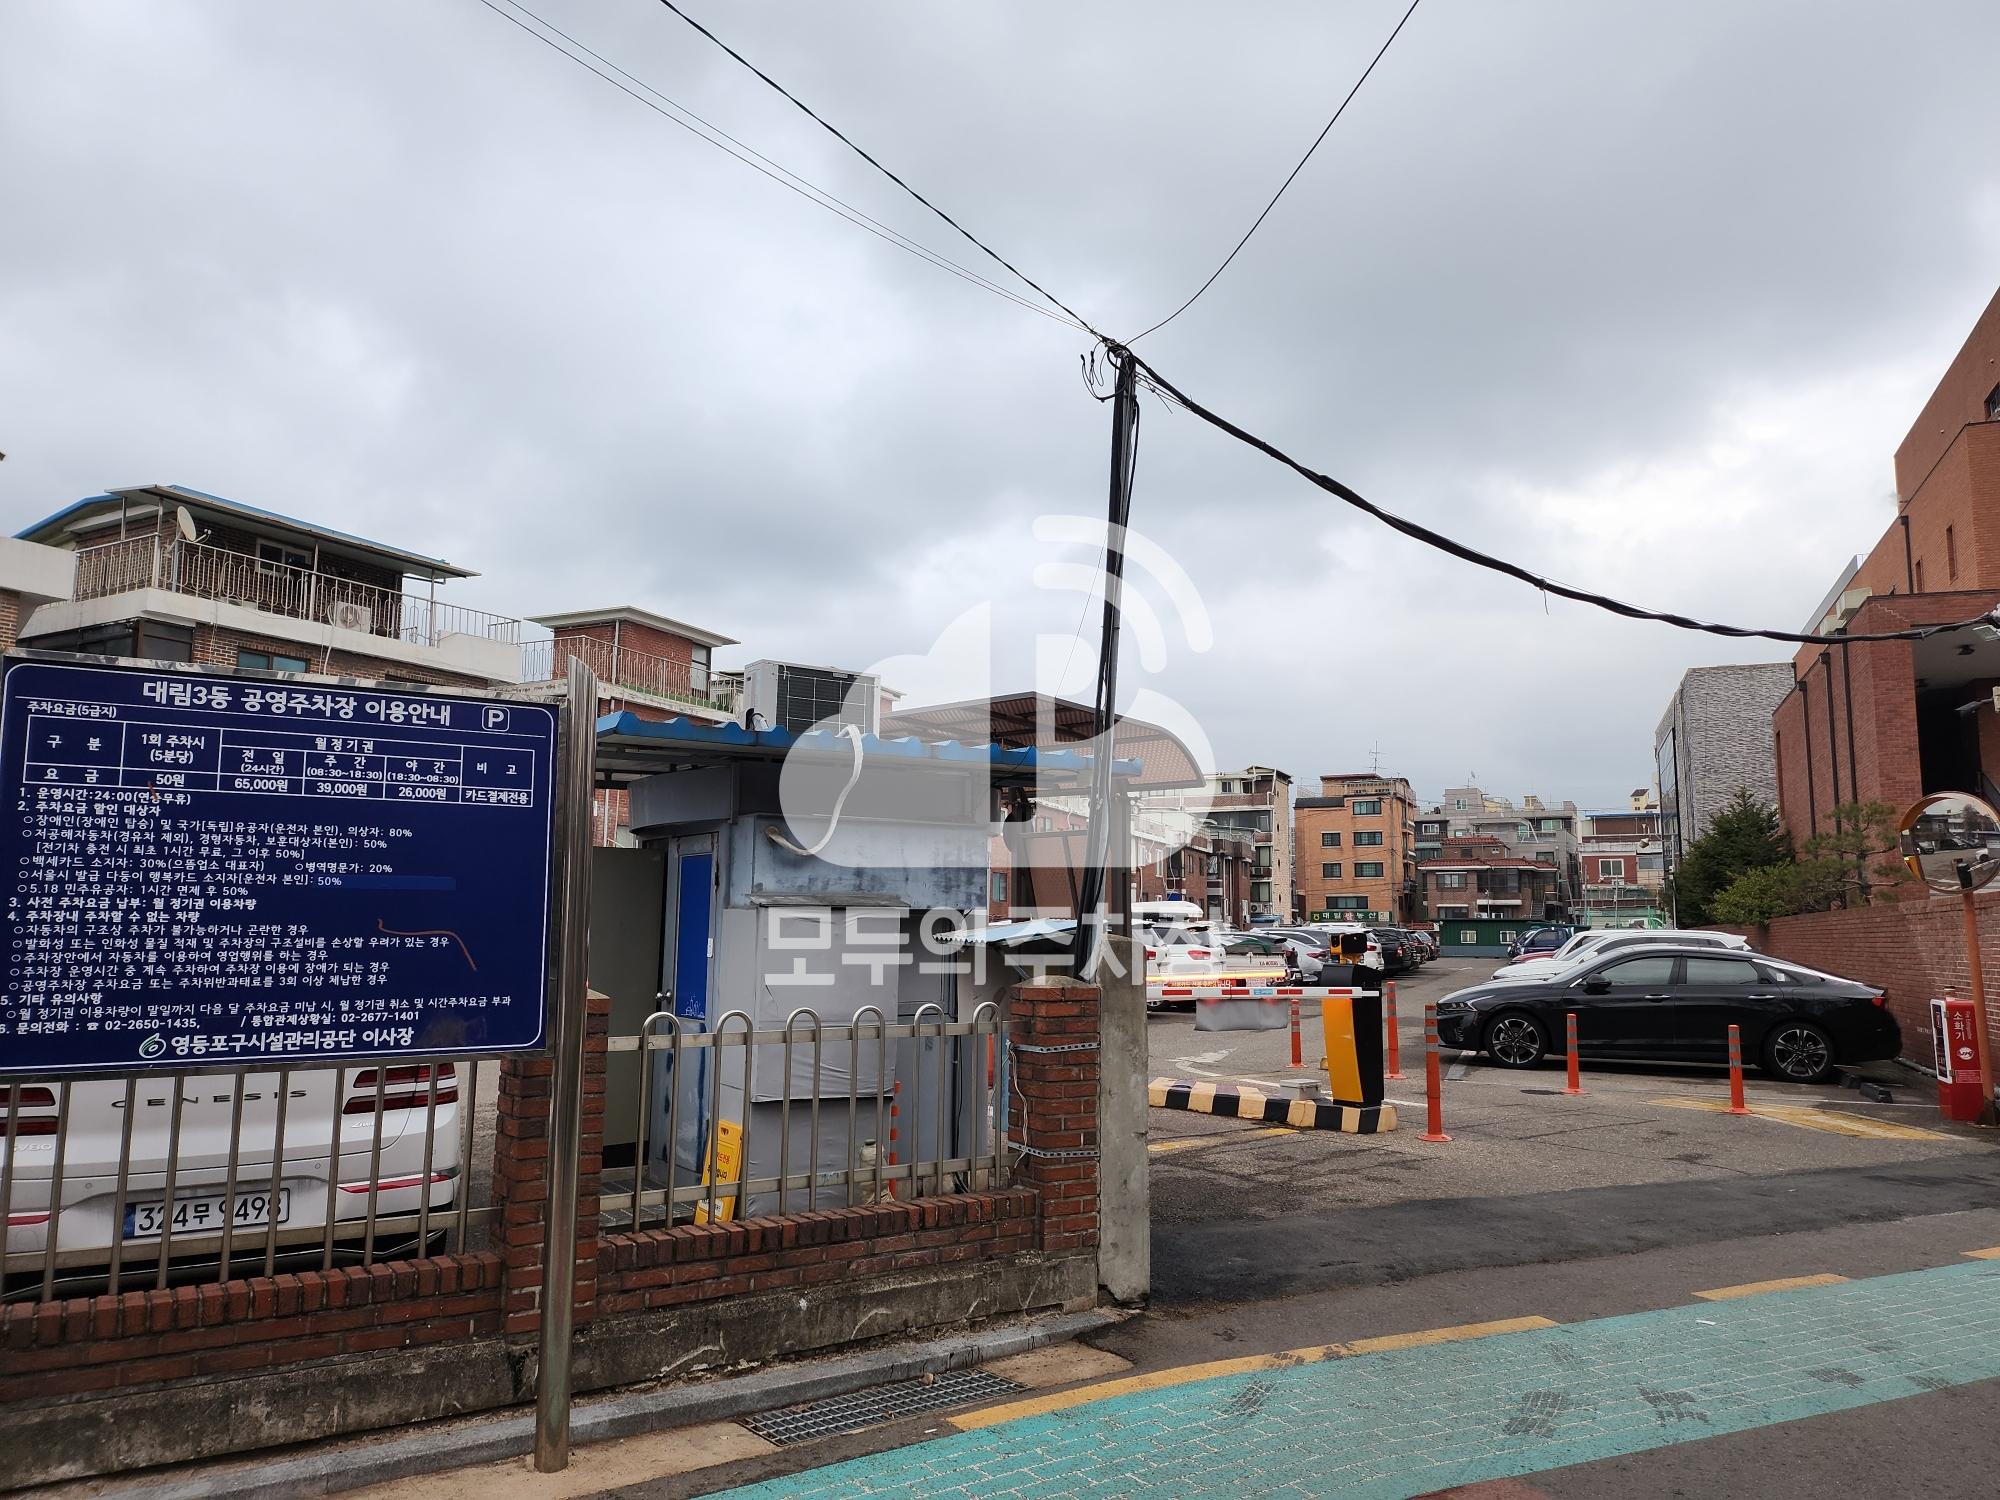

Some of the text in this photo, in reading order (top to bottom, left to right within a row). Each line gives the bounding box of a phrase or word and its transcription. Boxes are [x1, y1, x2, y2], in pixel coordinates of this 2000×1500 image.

[27, 701, 117, 718] 주차요금(5급지)
[142, 681, 450, 726] 대림3동 공영주차장 이용안내
[487, 709, 505, 728] P
[141, 733, 204, 752] 1회 주차시
[150, 748, 193, 764] (5분당)
[241, 764, 284, 776] (24시간)
[306, 767, 384, 781] (08:30~18:30)
[155, 773, 184, 788] 50원
[234, 778, 288, 792] 65,000원
[387, 772, 460, 786] (18:30~08:30)
[19, 787, 30, 797] 1.
[316, 782, 368, 796] 39,000원
[398, 787, 447, 800] 26,000원
[465, 790, 529, 804] 카드결제전용
[17, 800, 161, 817] 2. 주차요금 할인 대상자
[124, 817, 153, 830] 탑승)
[160, 819, 171, 830] 및
[348, 825, 383, 837] 의상자:
[389, 828, 412, 837] 80%
[363, 839, 387, 848] 50%
[85, 842, 109, 855] 충전
[115, 843, 126, 855] 시
[132, 844, 156, 855] 최초
[163, 845, 193, 857] 1시간
[231, 847, 242, 857] 그
[248, 847, 270, 859] 이후
[275, 849, 304, 860] 50%]
[32, 855, 84, 867] 백세카드
[90, 856, 132, 868] 소지자:
[225, 859, 264, 874] 대표자)
[305, 861, 392, 873] 병역명문가: 20%
[30, 868, 68, 881] 서울시
[75, 869, 100, 882] 발급
[106, 870, 142, 882] 다둥이
[149, 871, 197, 886] 행복카드
[282, 874, 313, 885] 본인]:
[317, 876, 341, 885] 50%
[29, 883, 248, 896] 5.18 민주유공자: 1시간 면제 후 50%
[8, 896, 256, 910] 3. 사전 주차요금 납부: 월 정기권 이용차량
[7, 910, 200, 923] 4. 주차장내 주차할 수 없는 차량
[26, 924, 308, 936] 자동차의 구조상 주차가 불가능하거나 곤란한 경우
[25, 936, 449, 950] 발화성 또는 인화성 물질 적재 및 주차장의 구조설비를 손상할 우려가 있는 경우
[23, 949, 328, 964] 주차장안에서 자동차를 이용하여 영업행위를 하는 경우
[22, 965, 62, 978] 주차장
[124, 964, 136, 977] 중
[142, 964, 166, 976] 계속
[172, 963, 219, 975] 주차하여
[225, 963, 260, 975] 주차장
[265, 962, 299, 974] 이용에
[304, 962, 338, 974] 장애가
[342, 961, 364, 973] 되는
[369, 961, 389, 973] 경우
[21, 979, 87, 992] 공영주차장
[92, 978, 143, 990] 주차요금
[149, 978, 173, 989] 또는
[279, 975, 296, 986] 3회
[302, 975, 324, 986] 이상
[328, 974, 362, 986] 체납한
[366, 974, 387, 985] 경우
[0, 992, 102, 1006] 5. 기타 유의사항
[18, 1008, 30, 1020] 월
[37, 1006, 73, 1019] 정기권
[79, 1005, 141, 1018] 이용차량이
[147, 1003, 194, 1016] 말일까지
[200, 1003, 223, 1015] 다음
[228, 1002, 240, 1014] 달
[244, 1001, 290, 1013] 주차요금
[294, 1000, 316, 1012] 미납
[339, 999, 349, 1011] 월
[354, 998, 384, 1010] 정기권
[389, 998, 409, 1009] 취소
[414, 997, 423, 1009] 및
[427, 996, 487, 1008] 시간주차요금
[491, 995, 511, 1006] 부과
[16, 1020, 69, 1034] 문의전화
[1953, 1011, 1965, 1041] 소화기
[171, 1026, 414, 1053] 영등포구시설관리공단 이사장
